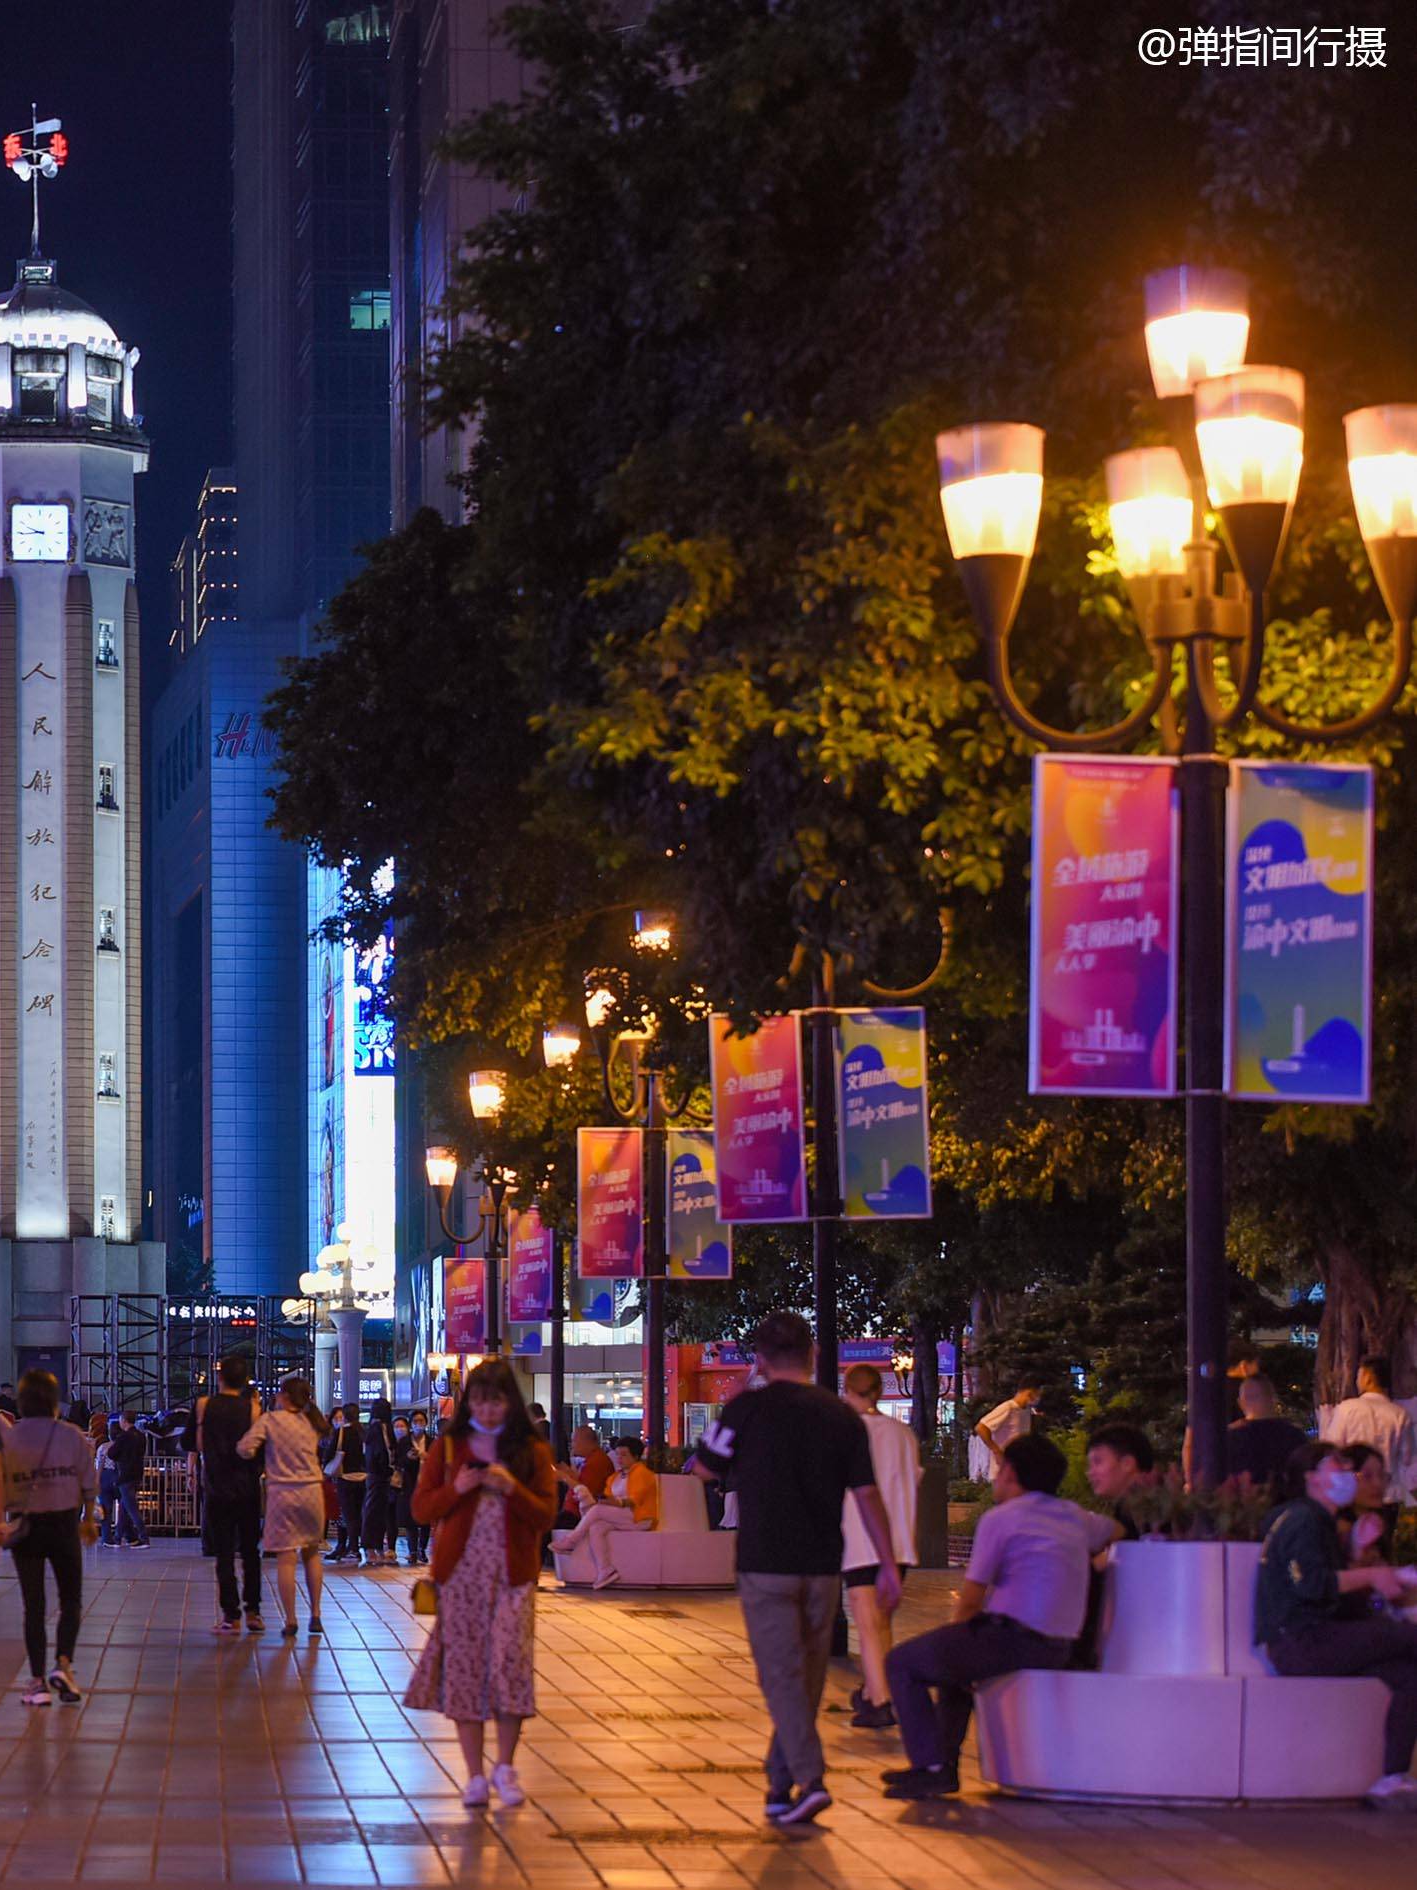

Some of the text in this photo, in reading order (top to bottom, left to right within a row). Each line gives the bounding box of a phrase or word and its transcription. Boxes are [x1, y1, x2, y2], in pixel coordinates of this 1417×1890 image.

[21, 661, 57, 1017] 人民解放纪念碑
